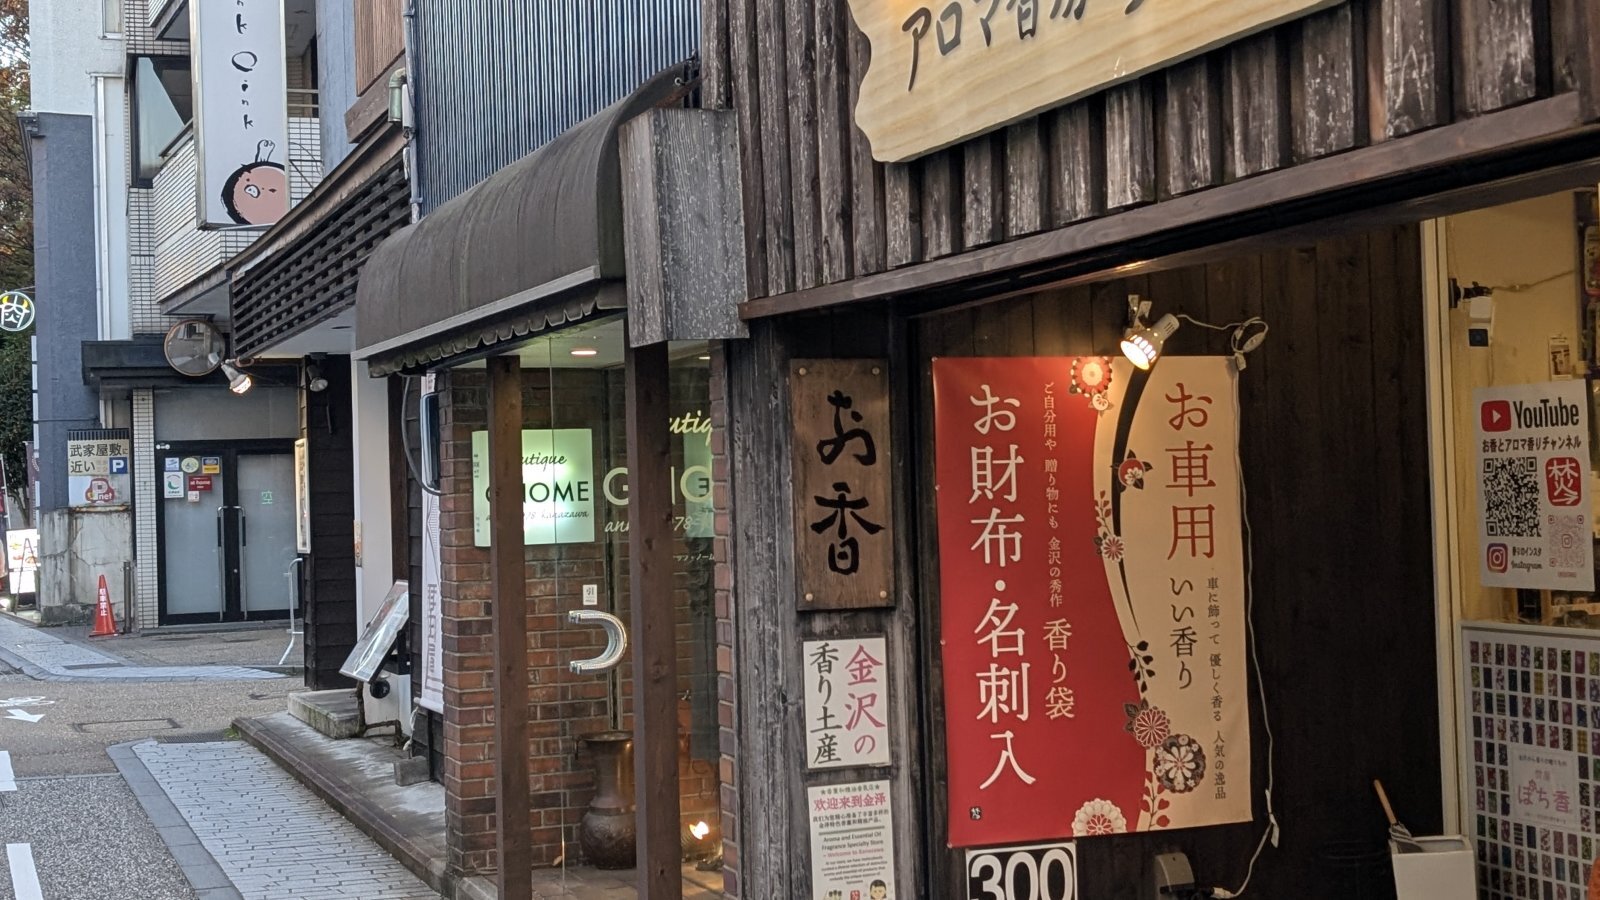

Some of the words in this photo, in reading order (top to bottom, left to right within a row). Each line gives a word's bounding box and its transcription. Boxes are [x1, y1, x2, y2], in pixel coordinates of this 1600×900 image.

[1043, 381, 1058, 451] ご自分用や
[1482, 434, 1582, 453] お香とアロマ香りチャンネル
[1513, 397, 1580, 429] YouTube
[69, 443, 128, 457] 武家屋敷に
[70, 460, 95, 473] 近い
[112, 460, 124, 473] P
[521, 452, 568, 473] utique
[810, 390, 885, 575] お香
[1164, 382, 1218, 560] お車用
[486, 481, 589, 504] OME
[1044, 458, 1060, 529] 贈り物にも
[968, 384, 1036, 789] お財布・名刺入
[1047, 536, 1064, 608] 金沢の秀作
[1511, 560, 1543, 573] Instagram
[1169, 576, 1199, 691] いい香り
[1207, 577, 1220, 645] 車に飾って
[845, 644, 885, 755] 金沢の
[1043, 617, 1075, 721] 香り袋
[1210, 653, 1223, 722] 優しく香る
[809, 643, 843, 765] 香り土産
[1213, 730, 1226, 800] 人気の逸品
[813, 792, 887, 811] 欢迎来到金泽
[971, 849, 1073, 900] 300
